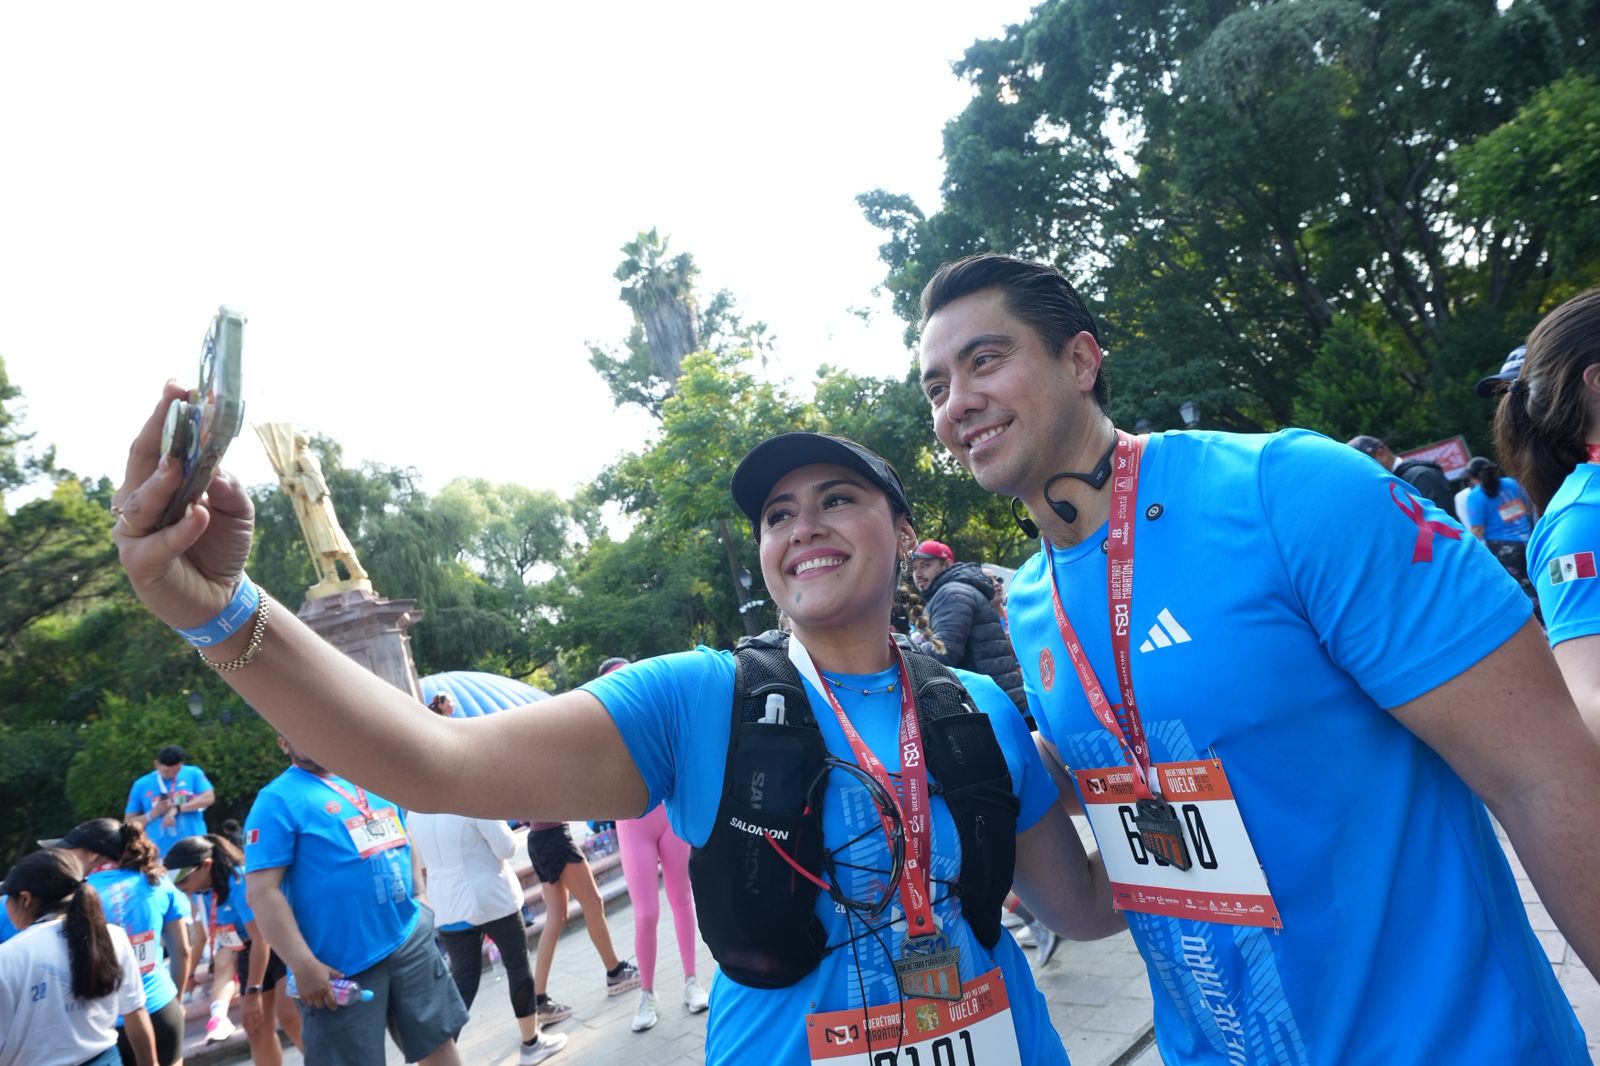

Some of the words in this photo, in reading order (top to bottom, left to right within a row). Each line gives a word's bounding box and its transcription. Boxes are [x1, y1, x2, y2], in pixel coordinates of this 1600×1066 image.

[1121, 564, 1133, 599] MARATÓN
[1167, 776, 1198, 793] VUELA
[729, 816, 789, 841] SALOMON
[948, 998, 979, 1023] VUELA
